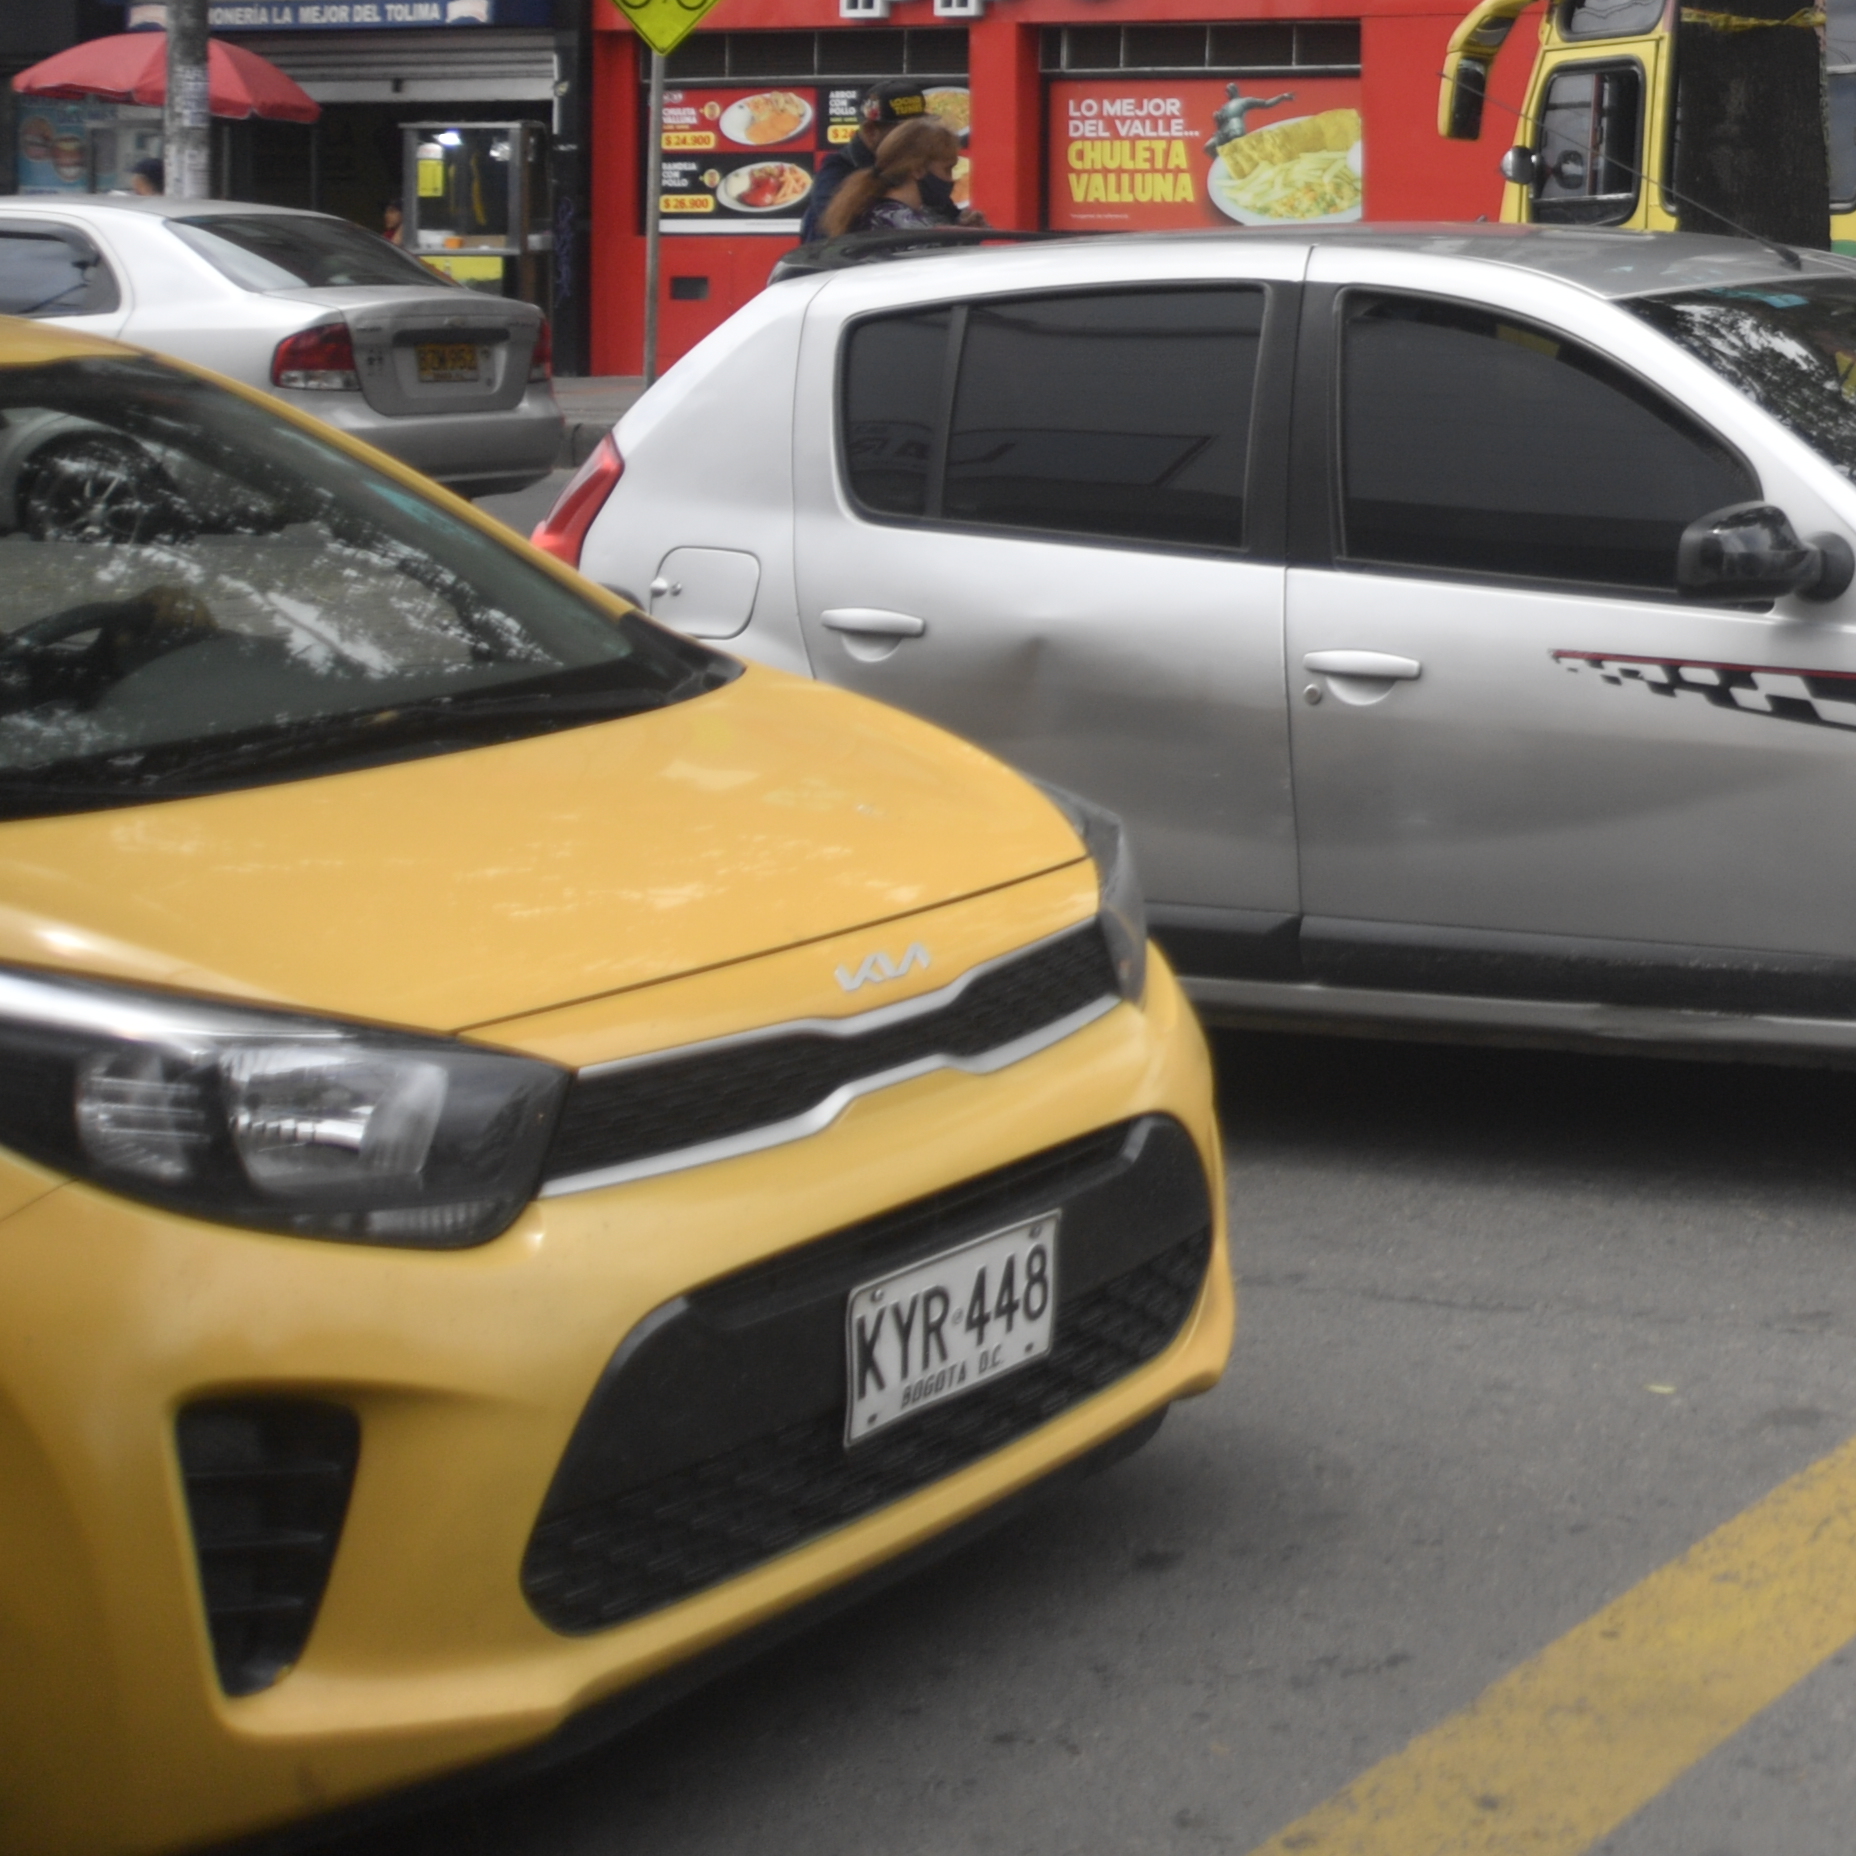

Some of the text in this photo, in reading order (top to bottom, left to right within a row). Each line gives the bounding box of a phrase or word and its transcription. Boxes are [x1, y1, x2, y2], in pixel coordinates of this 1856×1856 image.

[272, 5, 293, 24] LA
[299, 4, 349, 24] MEJOR
[353, 4, 381, 22] DEL
[385, 2, 441, 22] TOLIMA
[1068, 98, 1181, 117] LO MEJOR
[1068, 118, 1200, 137] DEL VALLE...
[1067, 139, 1188, 170] CHULETA
[1068, 172, 1195, 203] VALLUNA
[900, 1359, 967, 1407] BOGOTA
